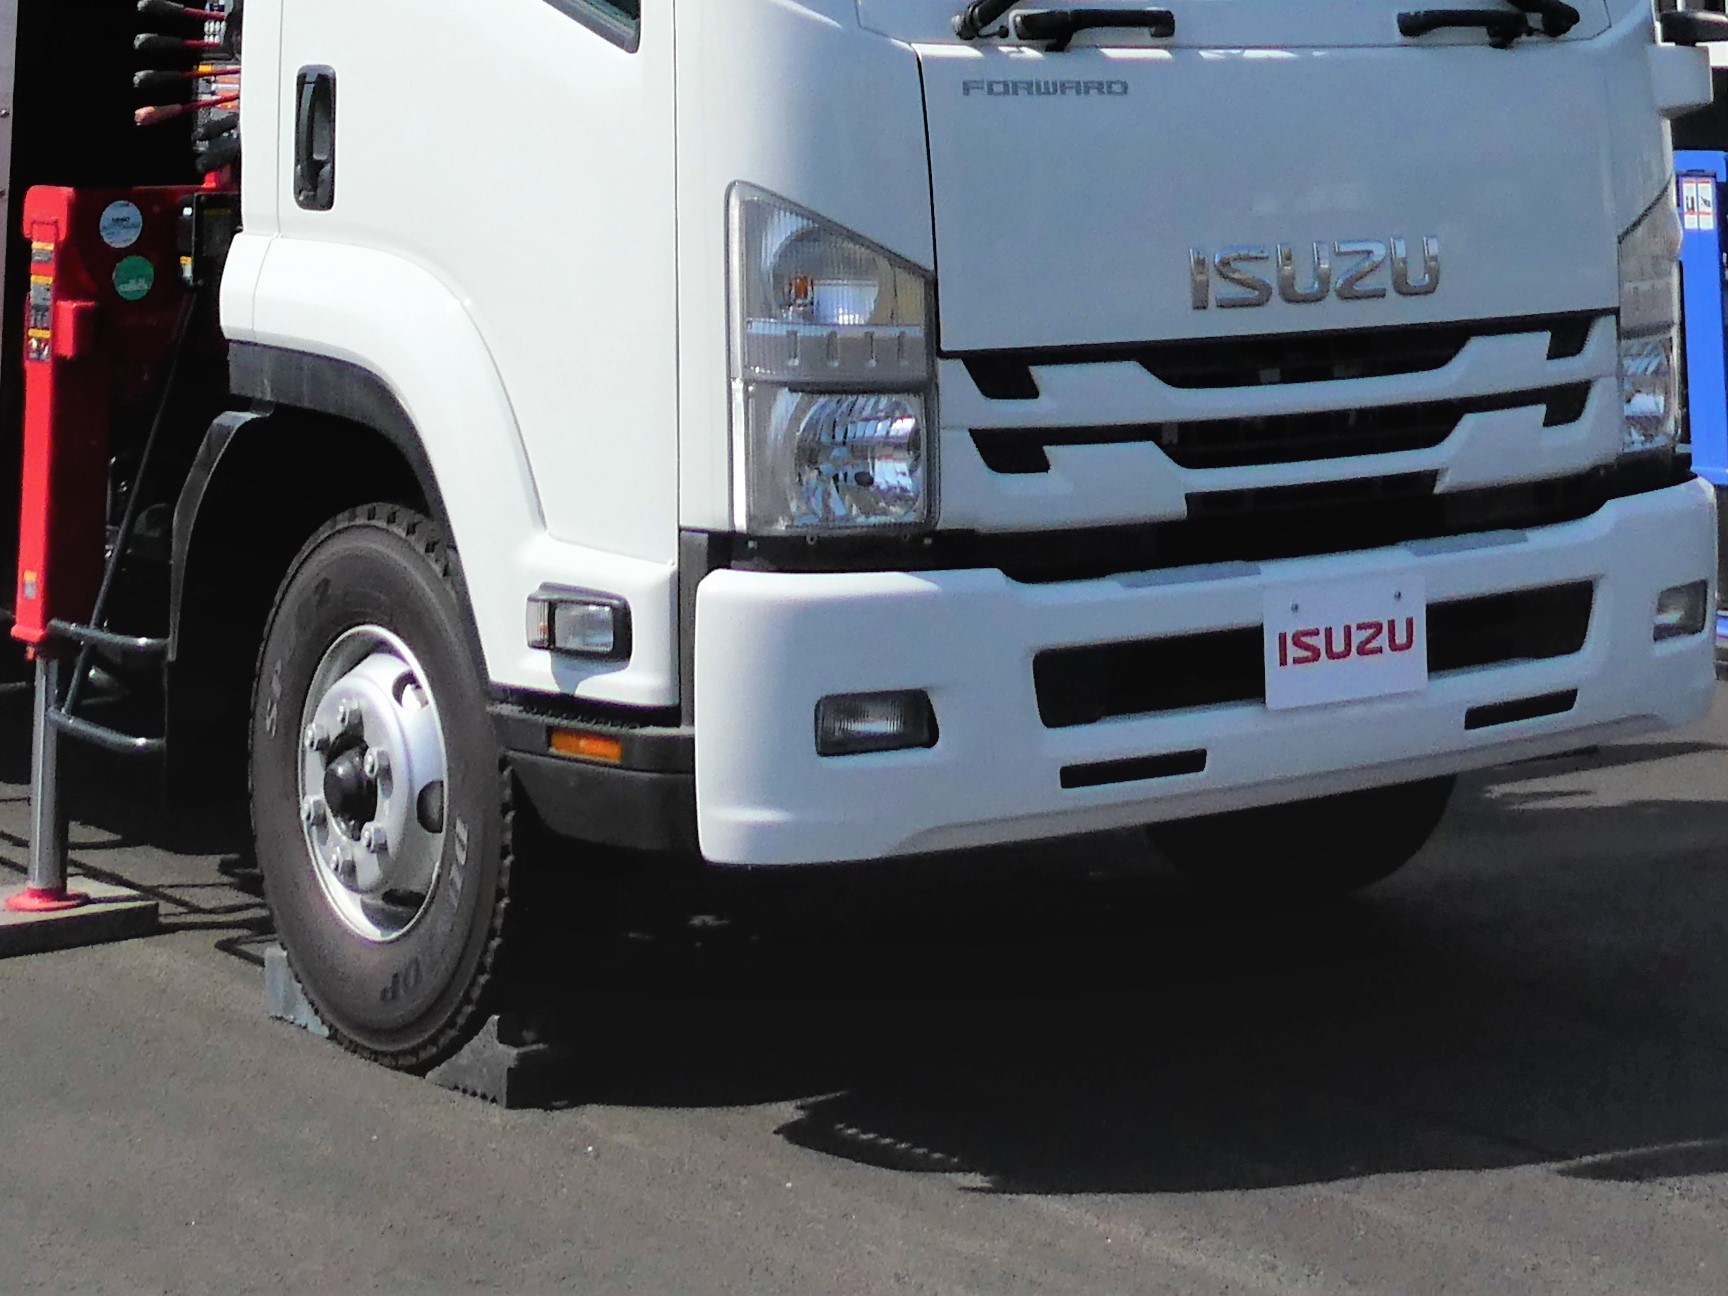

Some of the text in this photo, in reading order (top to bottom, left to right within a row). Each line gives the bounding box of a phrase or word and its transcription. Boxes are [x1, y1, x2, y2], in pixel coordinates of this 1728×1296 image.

[962, 79, 1129, 96] FORWARD
[1187, 235, 1441, 310] ISUZU
[1278, 616, 1416, 667] ISUZU
